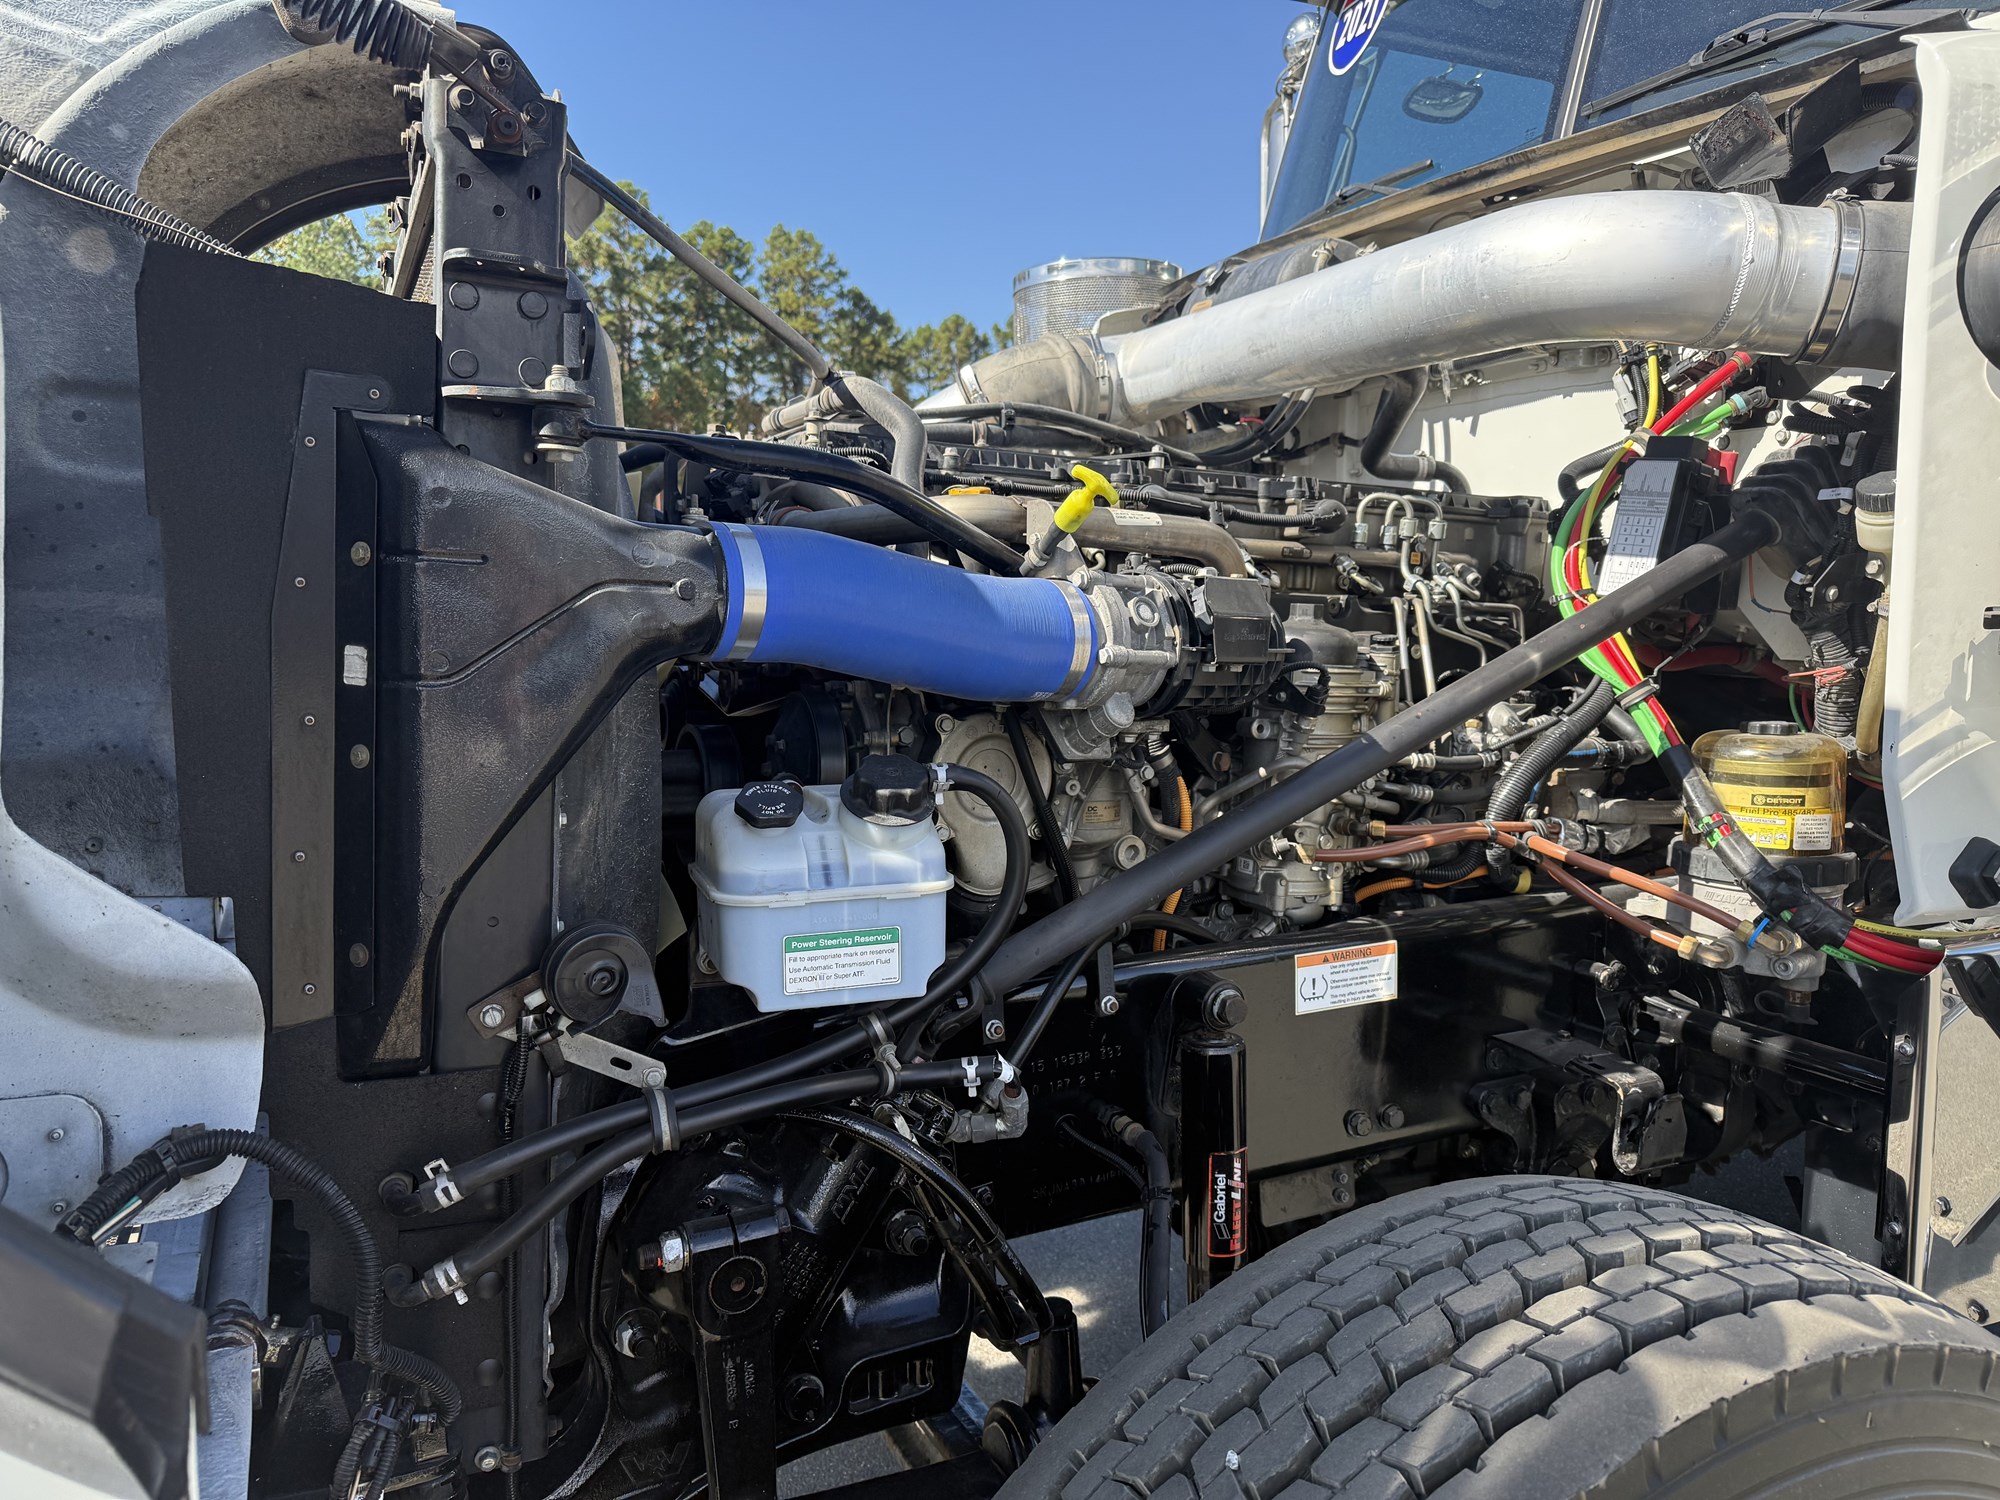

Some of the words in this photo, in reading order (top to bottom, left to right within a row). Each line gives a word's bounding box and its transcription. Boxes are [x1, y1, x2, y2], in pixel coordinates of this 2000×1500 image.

[1335, 0, 1379, 51] 2021
[745, 785, 760, 797] POWER
[763, 784, 791, 795] STEERING
[1740, 807, 1760, 815] Fuel
[1763, 807, 1779, 816] Pro
[791, 940, 817, 949] Power
[819, 937, 853, 947] Steering
[854, 933, 892, 943] Reservoir
[806, 952, 842, 963] appropriate
[843, 949, 859, 958] mark
[1332, 947, 1372, 961] WARNING
[788, 966, 802, 974] Use
[802, 964, 833, 973] Automatic
[835, 960, 875, 969] Transmission
[788, 975, 818, 984] DEXRON
[833, 972, 851, 980] Super
[1213, 1173, 1226, 1223] Gabriel
